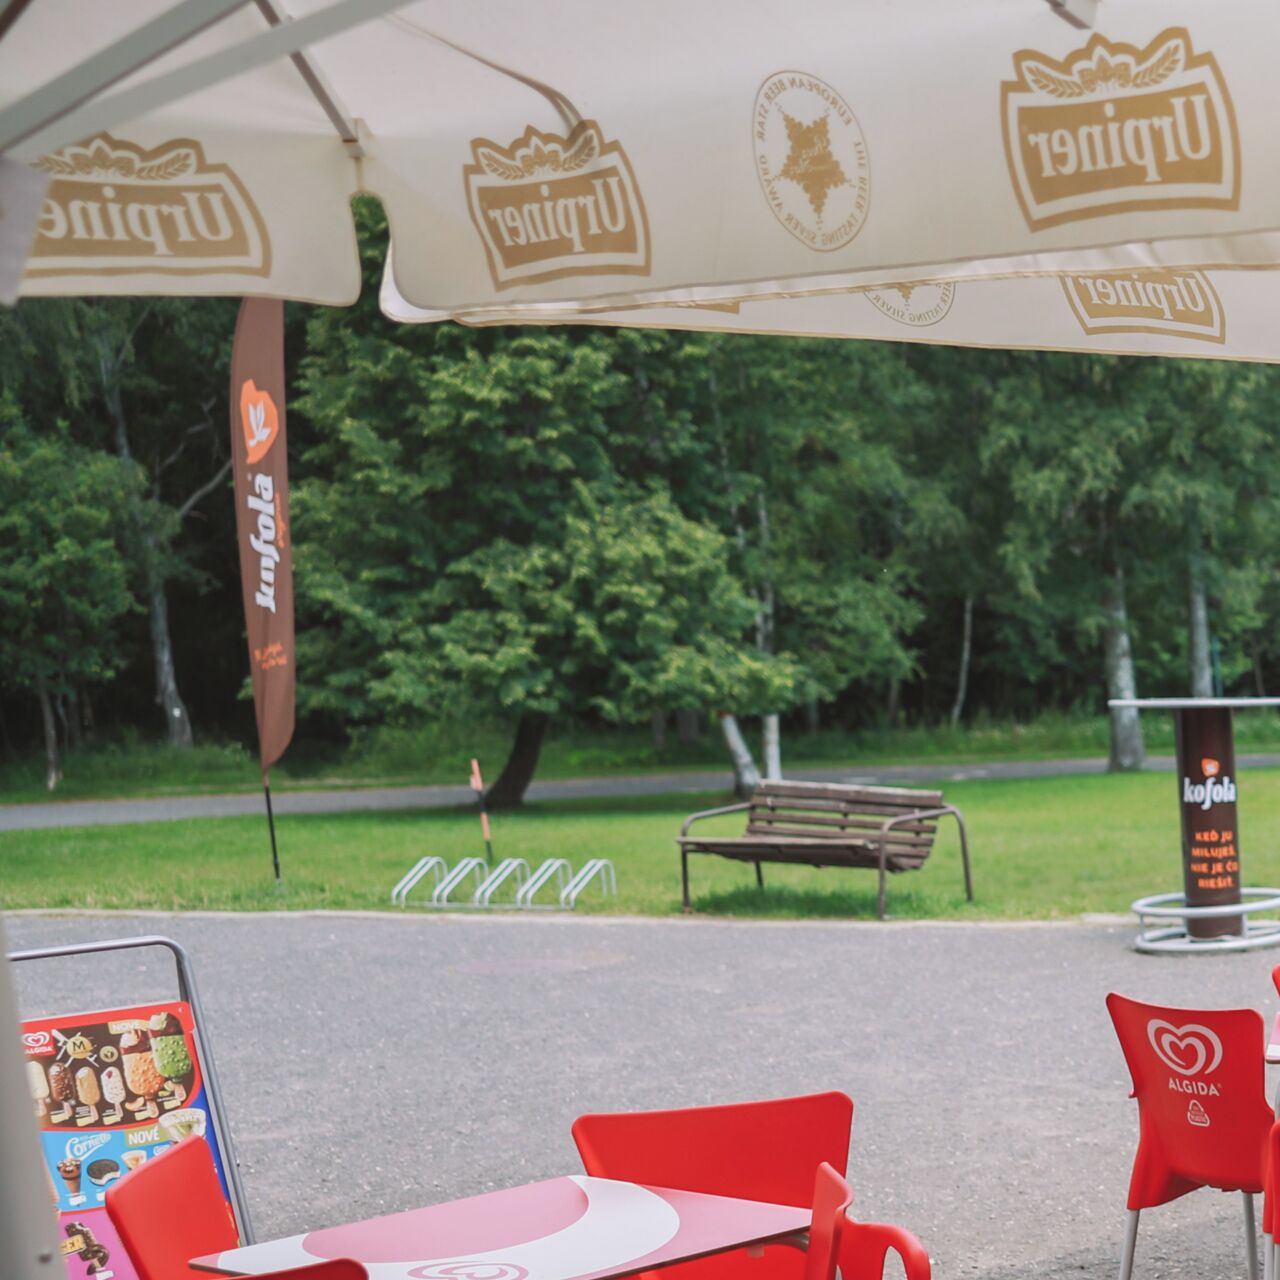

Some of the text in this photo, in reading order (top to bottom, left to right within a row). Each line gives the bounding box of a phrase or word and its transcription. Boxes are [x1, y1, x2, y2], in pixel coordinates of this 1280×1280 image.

[1183, 775, 1236, 811] kofola
[1168, 1077, 1220, 1096] ALGIDA
[128, 1130, 159, 1145] NOVÉ
